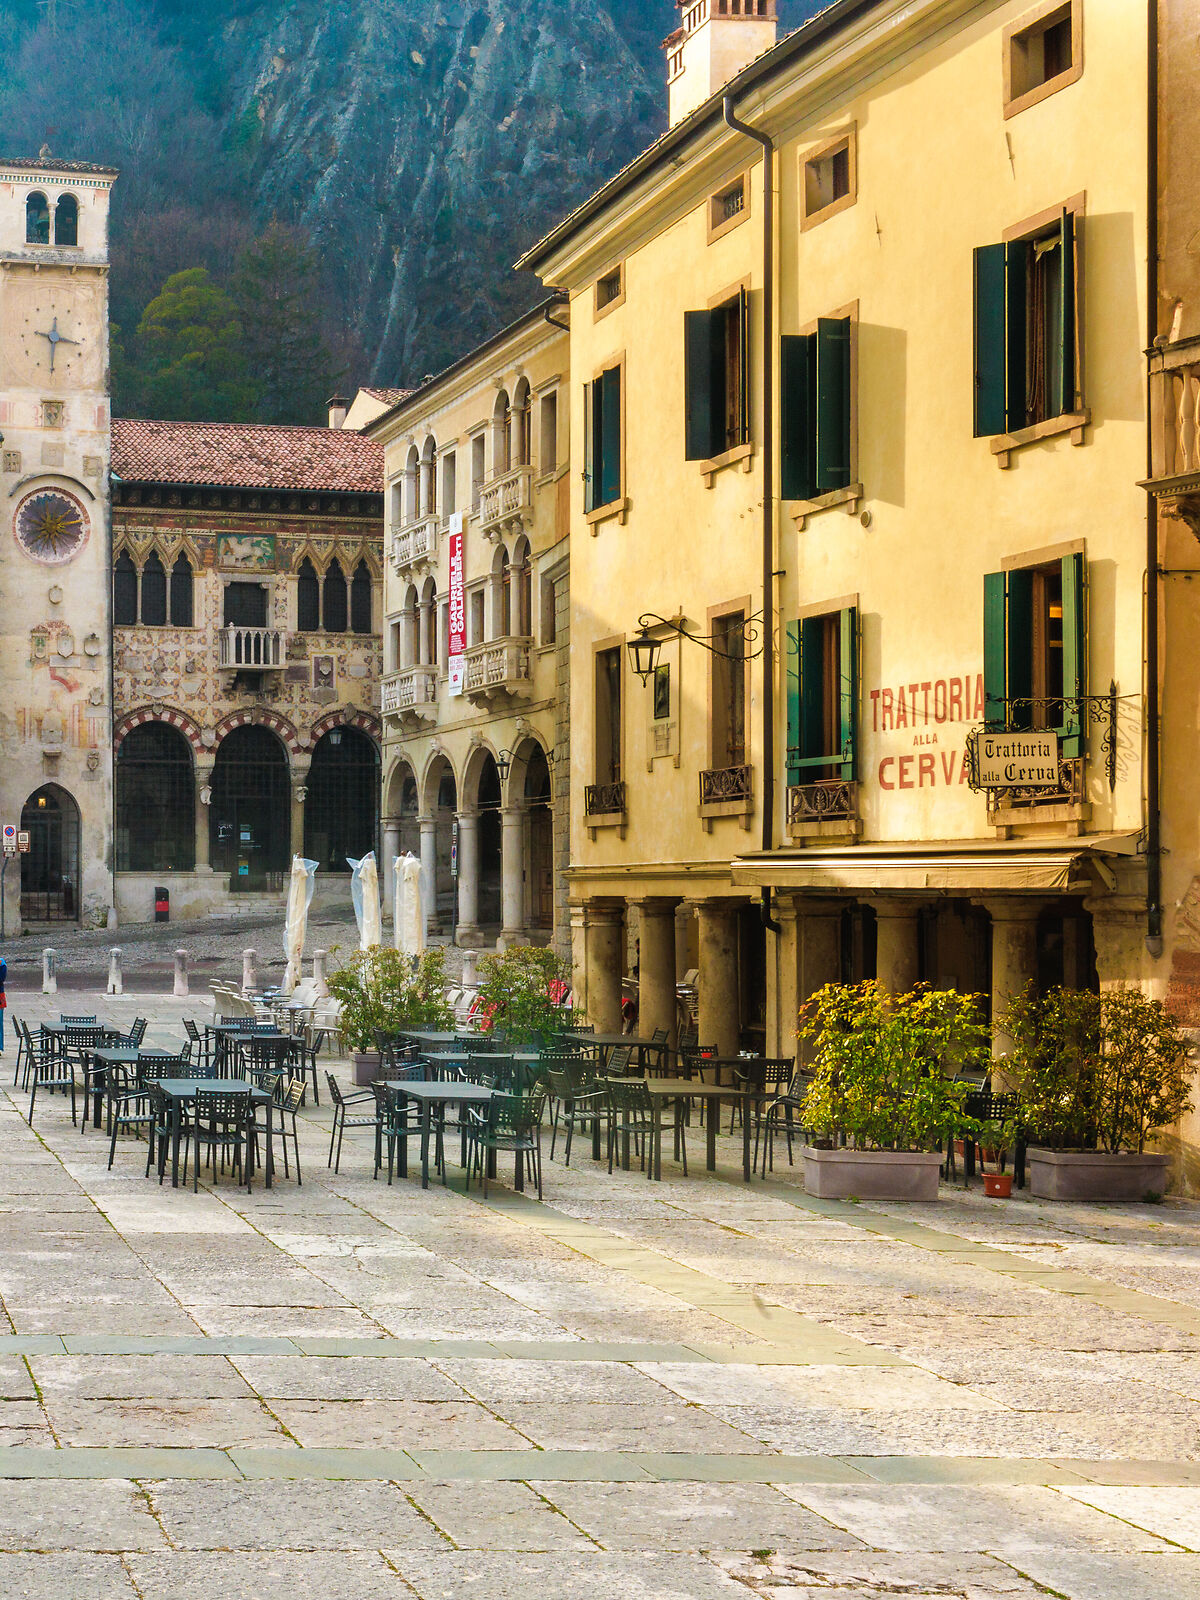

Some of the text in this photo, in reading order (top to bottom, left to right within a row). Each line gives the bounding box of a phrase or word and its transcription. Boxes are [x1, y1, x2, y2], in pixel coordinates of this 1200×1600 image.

[456, 535, 464, 633] GALIMBERTI
[870, 673, 984, 732] TRATTORIA
[913, 733, 938, 746] ALLA
[984, 740, 1051, 759] Trattoria
[982, 763, 1056, 782] alla Cerva
